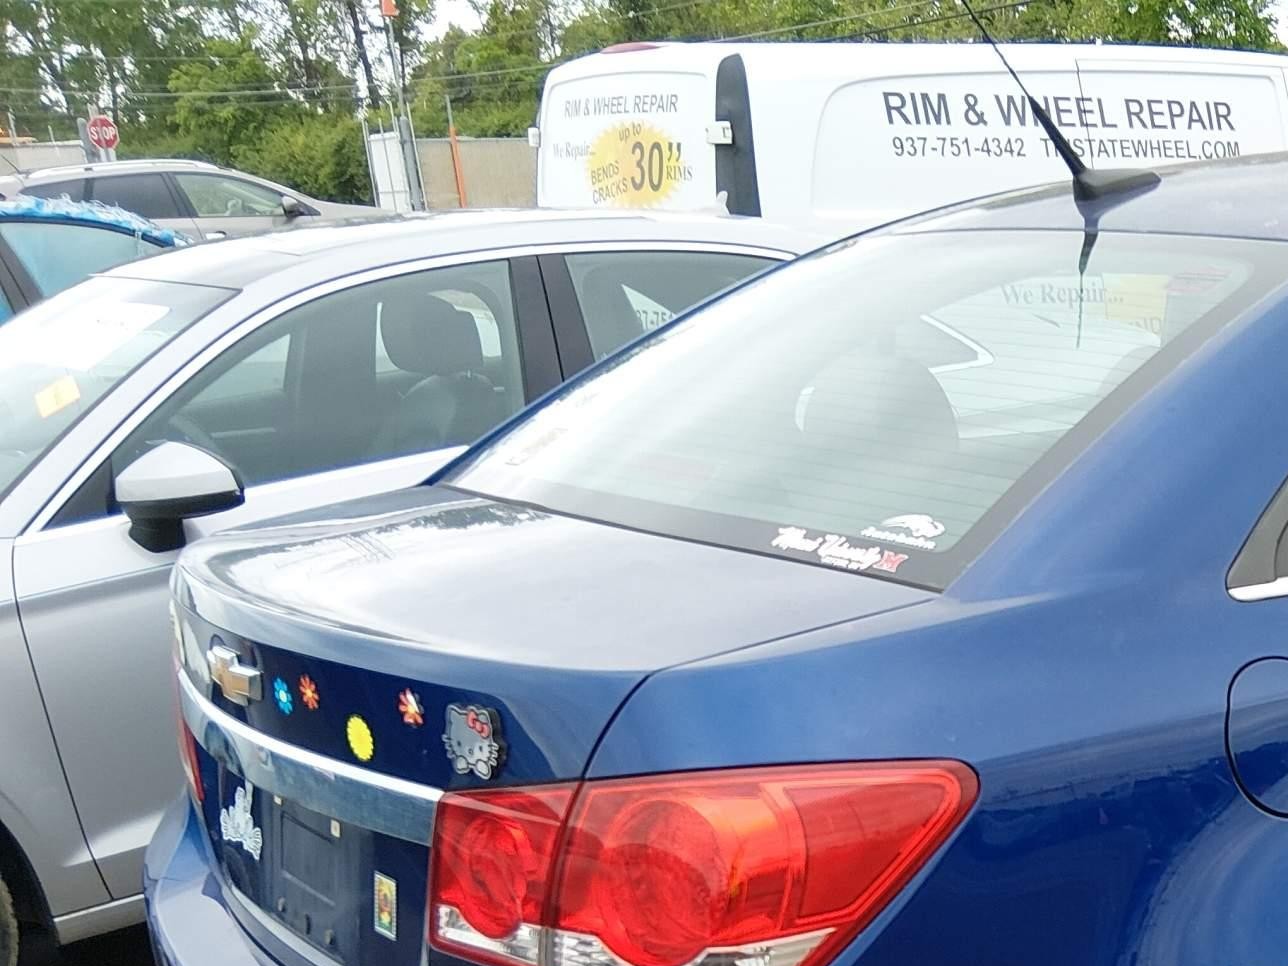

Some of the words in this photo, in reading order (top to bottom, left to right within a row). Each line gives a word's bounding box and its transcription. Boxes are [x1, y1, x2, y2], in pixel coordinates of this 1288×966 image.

[564, 98, 581, 120] RIM
[583, 97, 590, 117] &
[593, 95, 629, 116] WHEEL
[633, 93, 679, 114] REPAIR
[882, 91, 951, 126] RIM
[963, 93, 988, 126] &
[1124, 98, 1236, 131] REPAIR
[618, 127, 631, 143] up
[632, 121, 642, 137] to
[892, 136, 1027, 158] 937-751-4342
[1040, 137, 1241, 160] TSTATEWHEEL.COM
[591, 160, 620, 186] BENDS
[666, 164, 693, 182] RIMS
[592, 177, 628, 205] CRACKS
[1000, 283, 1033, 304] We
